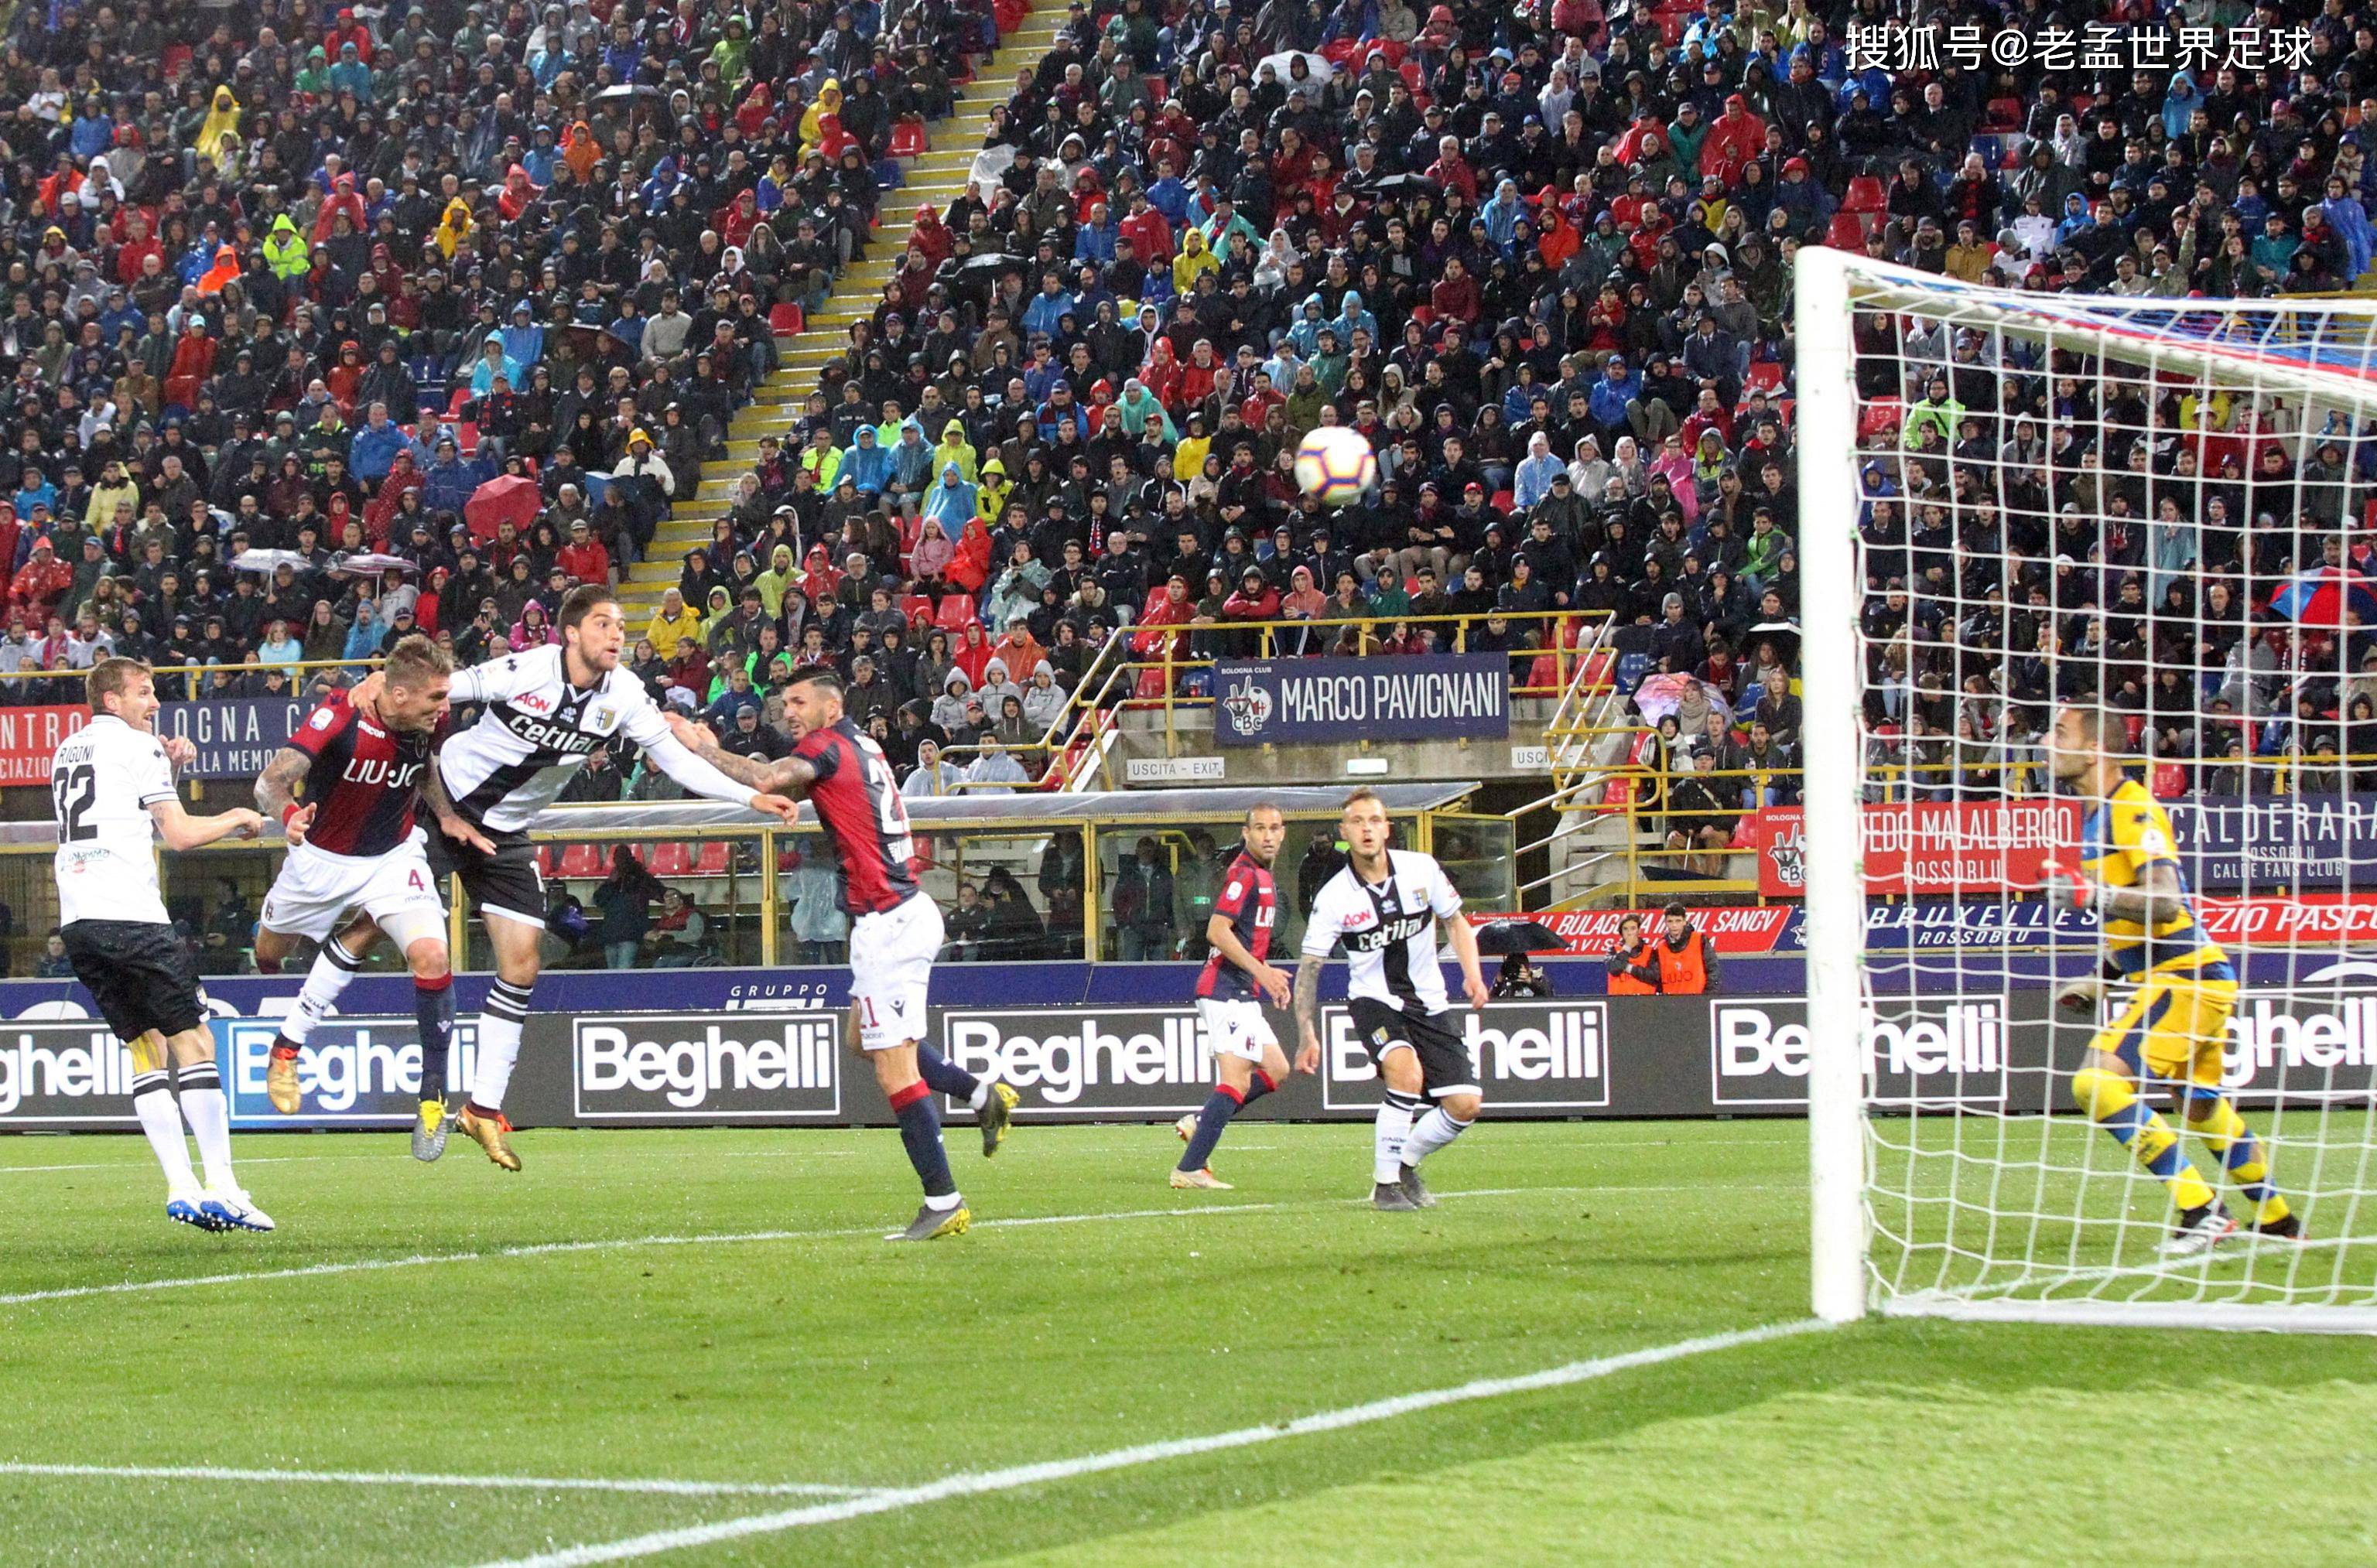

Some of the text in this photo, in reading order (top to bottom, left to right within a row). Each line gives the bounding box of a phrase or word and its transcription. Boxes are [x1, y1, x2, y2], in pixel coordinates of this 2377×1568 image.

[514, 692, 550, 712] AON
[1281, 671, 1500, 723] MARCO PAVIGNANI
[1234, 715, 1262, 729] CBC
[57, 744, 95, 764] RIGONI
[1133, 764, 1176, 775] USCITA
[1193, 762, 1219, 774] EXIT
[53, 764, 98, 844] 32
[1922, 807, 2072, 851] MALALBERGO
[409, 869, 424, 891] 4
[1903, 859, 2002, 886] ROSSOBLU
[2265, 862, 2300, 878] FANS
[2307, 861, 2344, 877] CLUB
[1342, 911, 1372, 927] AON
[1712, 909, 1780, 933] SANGV
[1868, 904, 2098, 929] BRUXELLES
[1918, 929, 2030, 945] ROSSOBLU
[730, 984, 827, 997] GRUPPO
[1720, 1003, 1996, 1076] Behelli
[581, 1025, 829, 1109] Beghelli
[953, 1018, 1212, 1103] Beghelli
